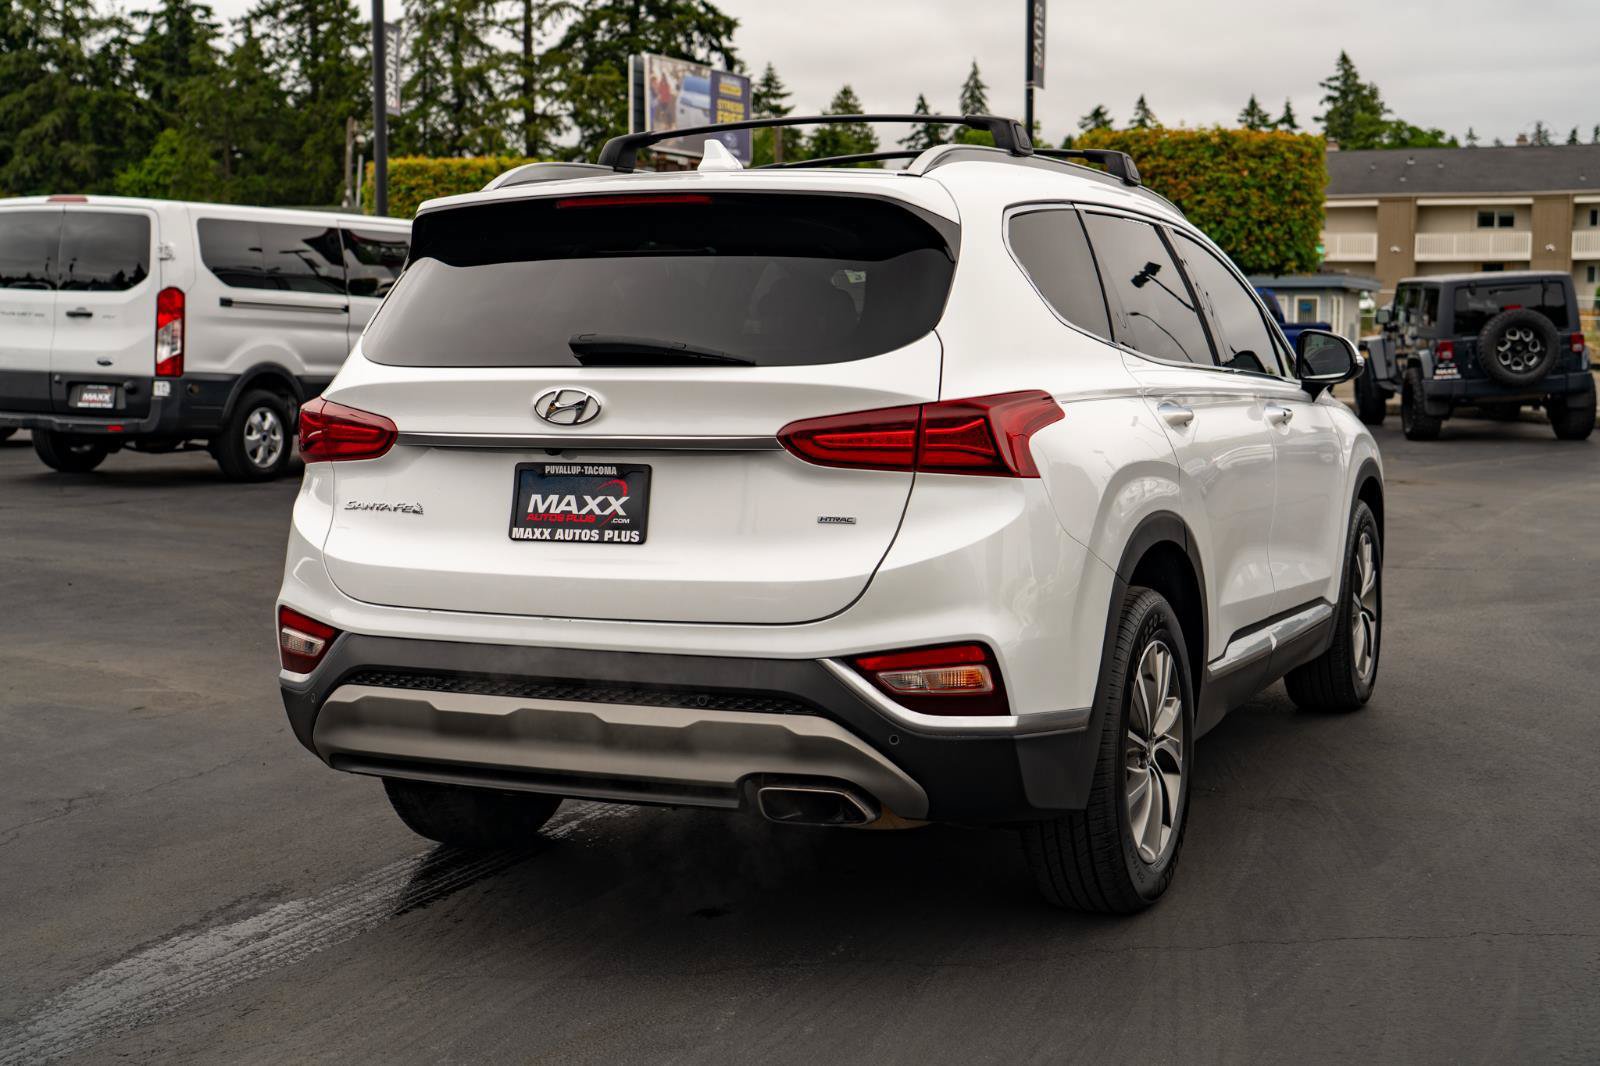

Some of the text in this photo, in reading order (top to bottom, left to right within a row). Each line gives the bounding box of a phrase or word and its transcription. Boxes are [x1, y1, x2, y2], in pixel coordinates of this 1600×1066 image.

[384, 30, 397, 108] TRUCKS
[82, 393, 111, 401] MAXX
[344, 501, 392, 512] SANTA
[527, 494, 630, 516] MAXX
[526, 513, 596, 523] AUTOS PLUS
[512, 528, 640, 543] MAXX AUTOS PLUS
